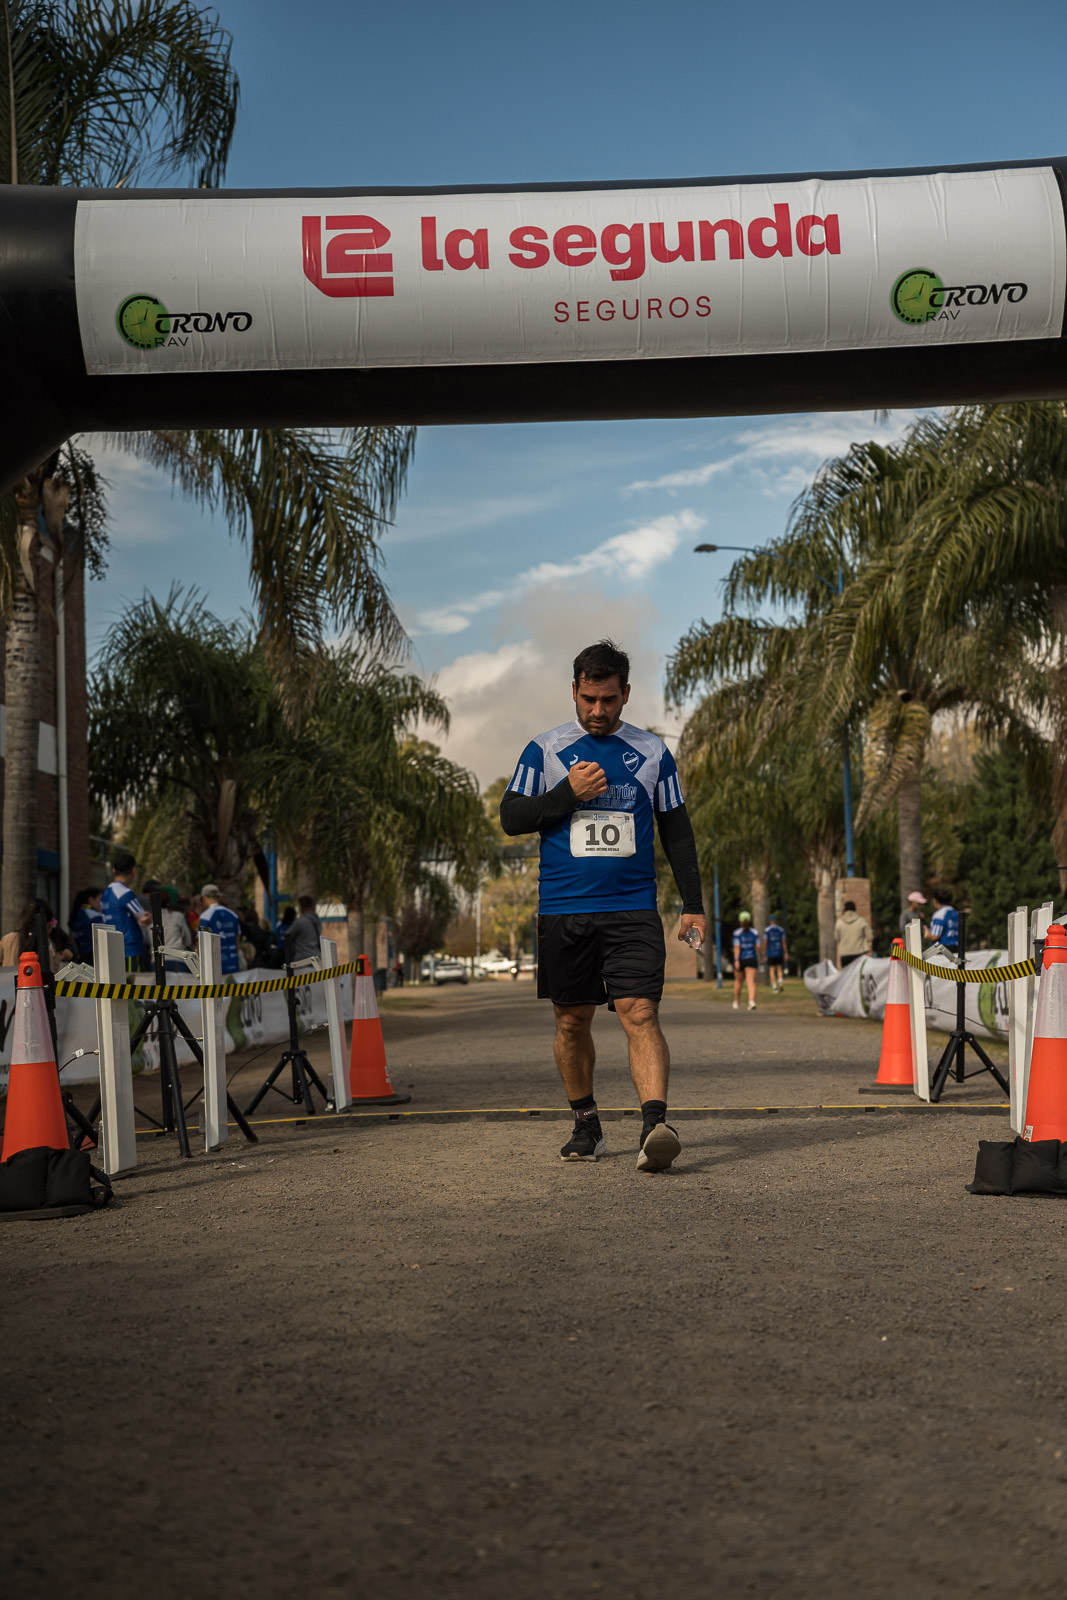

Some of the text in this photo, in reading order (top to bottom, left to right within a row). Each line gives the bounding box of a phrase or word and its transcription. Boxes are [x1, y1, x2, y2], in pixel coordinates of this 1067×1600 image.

[420, 203, 841, 281] la segunda
[928, 282, 1028, 308] CRONO
[553, 296, 712, 323] SEGUROS
[925, 309, 961, 322] RAV
[154, 311, 253, 334] CRONO
[154, 336, 189, 348] RAV
[585, 823, 620, 846] 10
